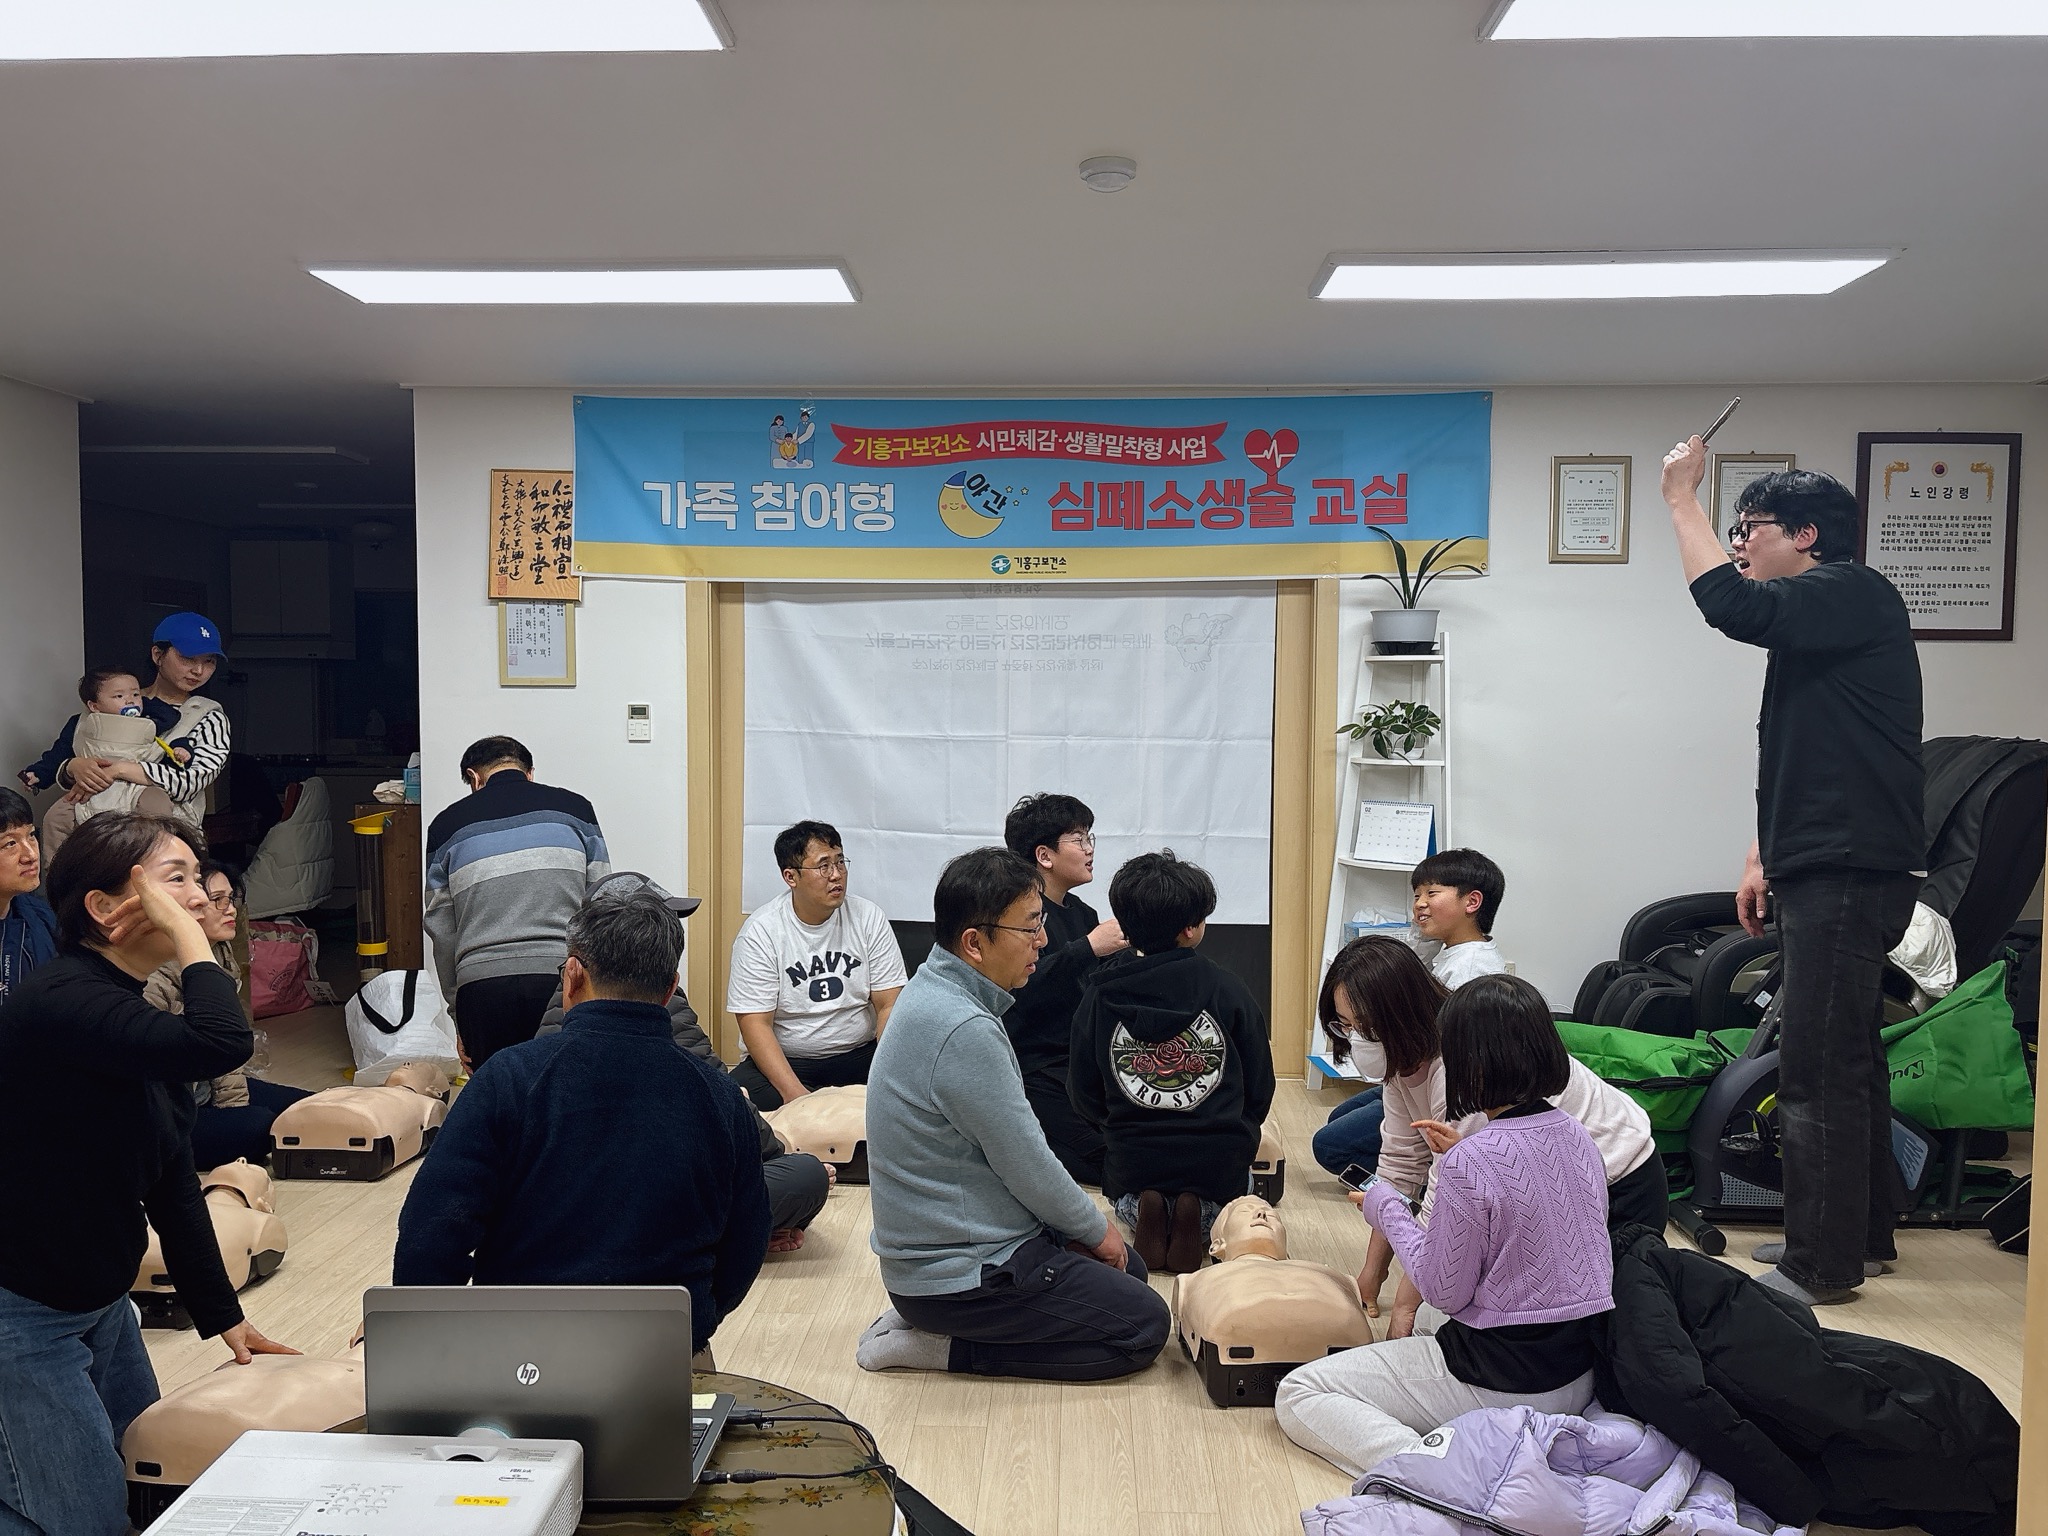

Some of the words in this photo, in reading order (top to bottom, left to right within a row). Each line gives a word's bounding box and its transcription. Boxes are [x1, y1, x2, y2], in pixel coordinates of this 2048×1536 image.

[852, 433, 972, 461] 기흥구보건소
[976, 428, 1163, 461] 시민체감·생활밀착형
[1166, 434, 1207, 460] 사업
[643, 481, 739, 530] 가족
[751, 481, 896, 533] 참여형
[966, 472, 1007, 516] 야간
[1048, 476, 1297, 532] 심폐소생술
[1308, 473, 1408, 527] 교실
[1013, 556, 1067, 570] 기흥구보건소
[785, 951, 861, 987] NAVY
[819, 980, 830, 999] 3
[520, 1363, 537, 1385] hp
